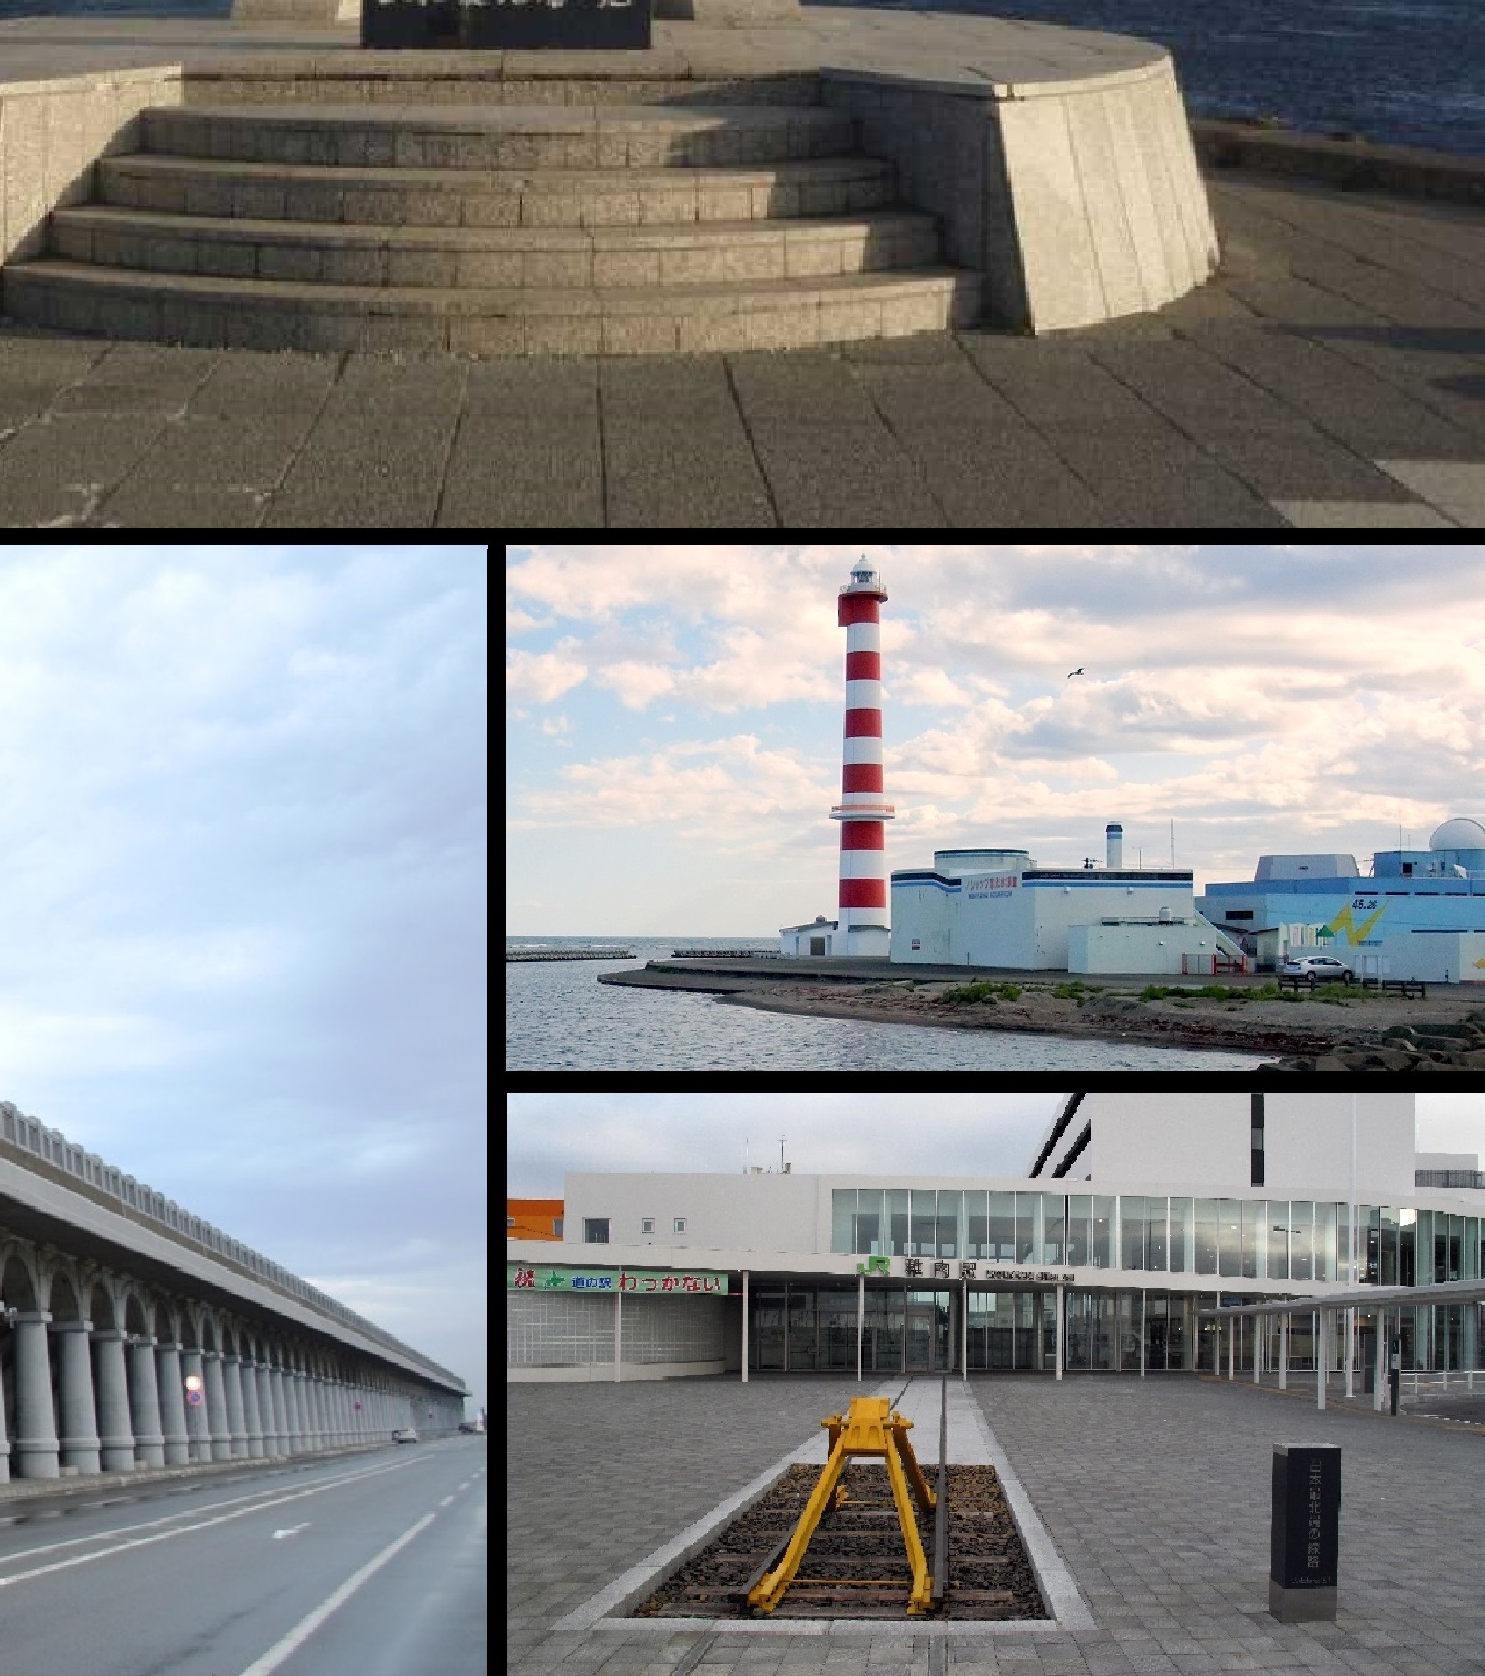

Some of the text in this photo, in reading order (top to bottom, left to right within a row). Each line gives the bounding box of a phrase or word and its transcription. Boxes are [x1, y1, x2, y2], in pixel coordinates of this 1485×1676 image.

[856, 1255, 891, 1274] JR
[618, 1271, 721, 1292] わっかない
